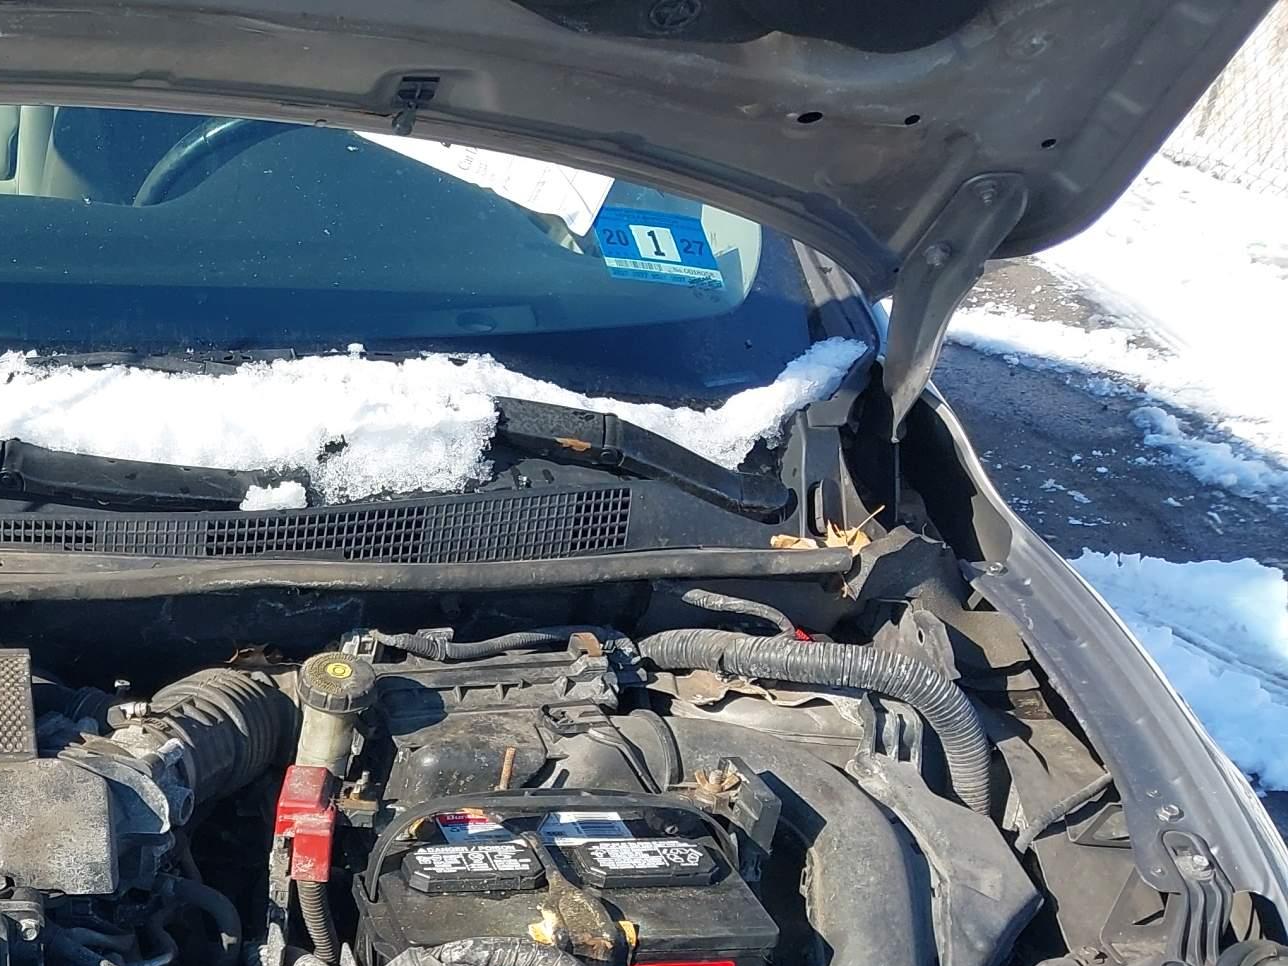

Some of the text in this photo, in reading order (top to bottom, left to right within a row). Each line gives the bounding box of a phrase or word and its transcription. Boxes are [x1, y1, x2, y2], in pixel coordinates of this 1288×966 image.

[602, 228, 704, 257] 20 1 27
